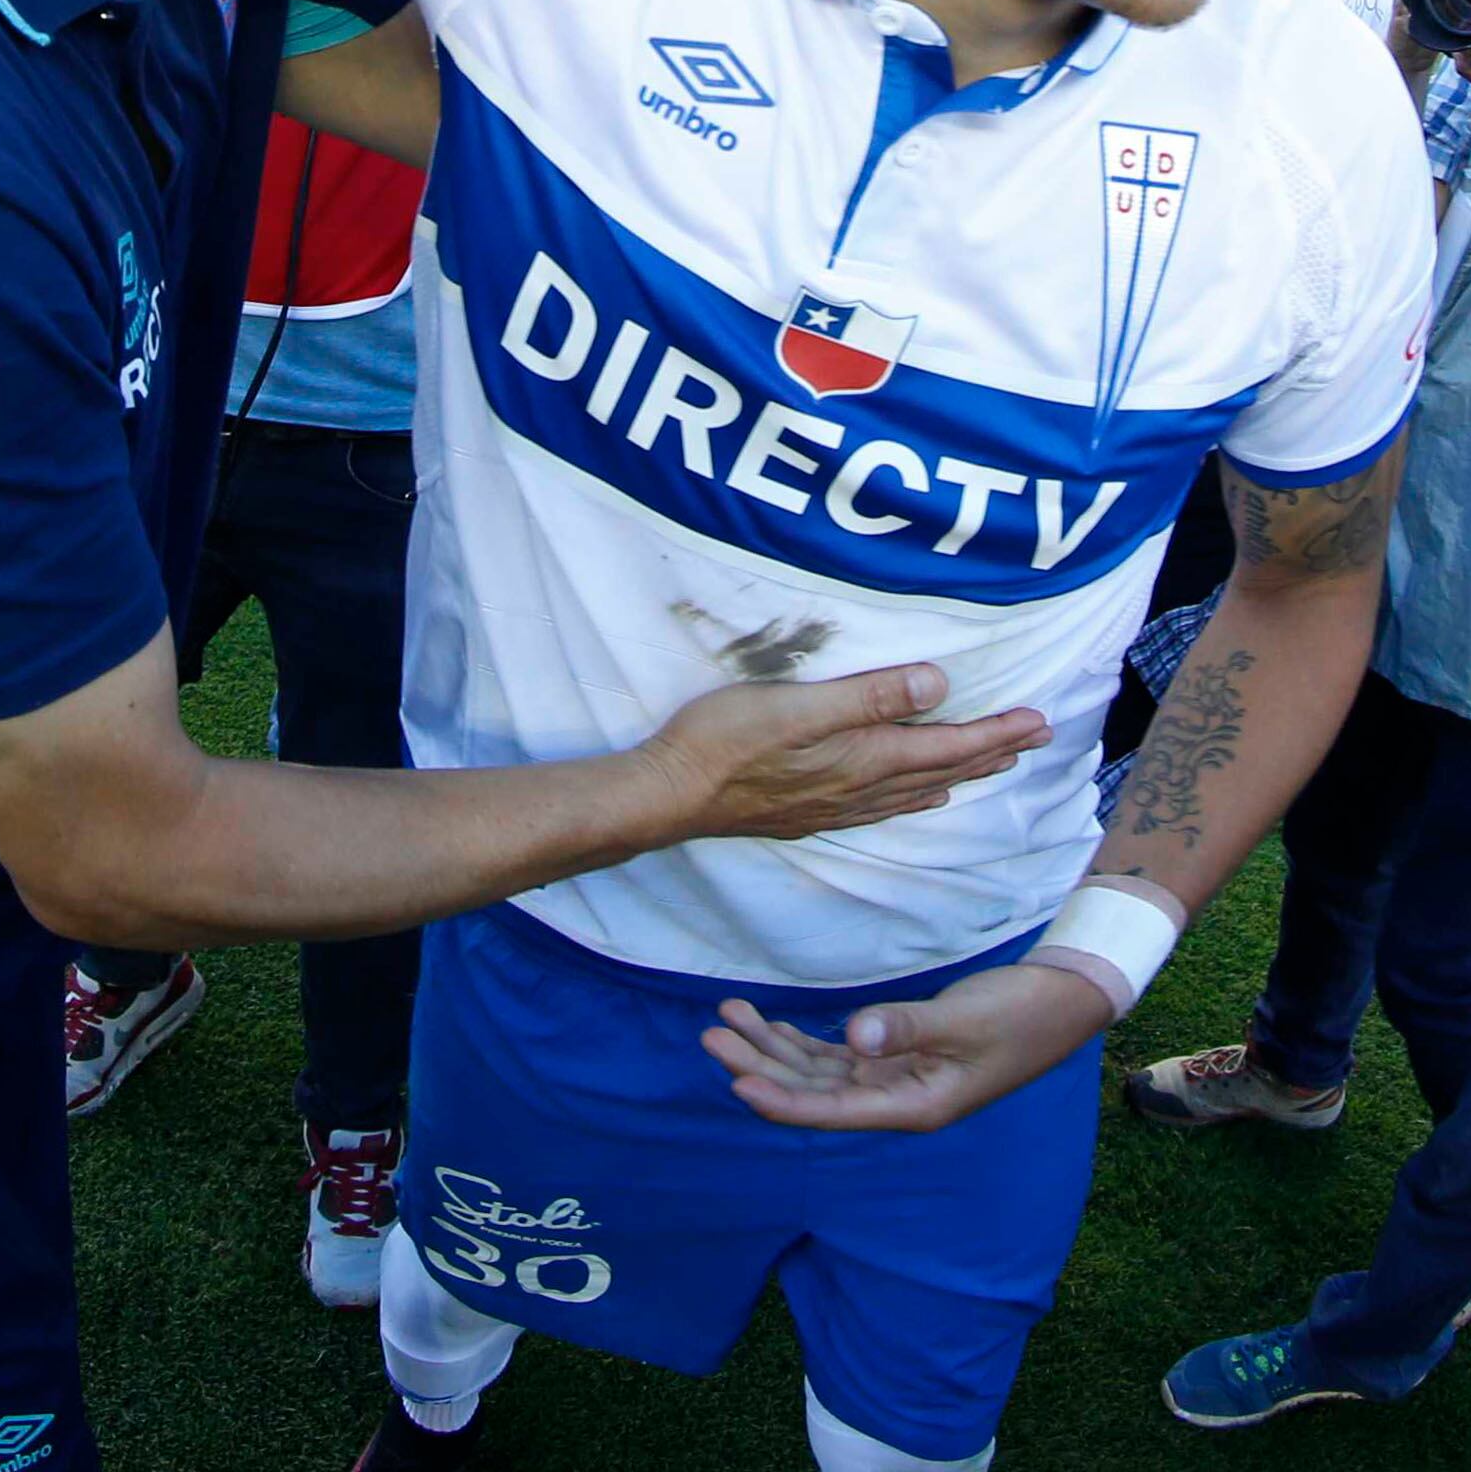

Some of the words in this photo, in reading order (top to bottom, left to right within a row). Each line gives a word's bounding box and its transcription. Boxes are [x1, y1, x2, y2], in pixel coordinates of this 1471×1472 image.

[638, 85, 737, 152] umbro
[1120, 148, 1136, 169] C
[1158, 152, 1174, 174] D
[1117, 191, 1134, 214] U
[1154, 196, 1171, 218] C
[500, 250, 1127, 571] DIRECTV
[434, 1165, 593, 1230] Stoli
[424, 1215, 612, 1303] 30
[540, 1238, 584, 1249] VODKA
